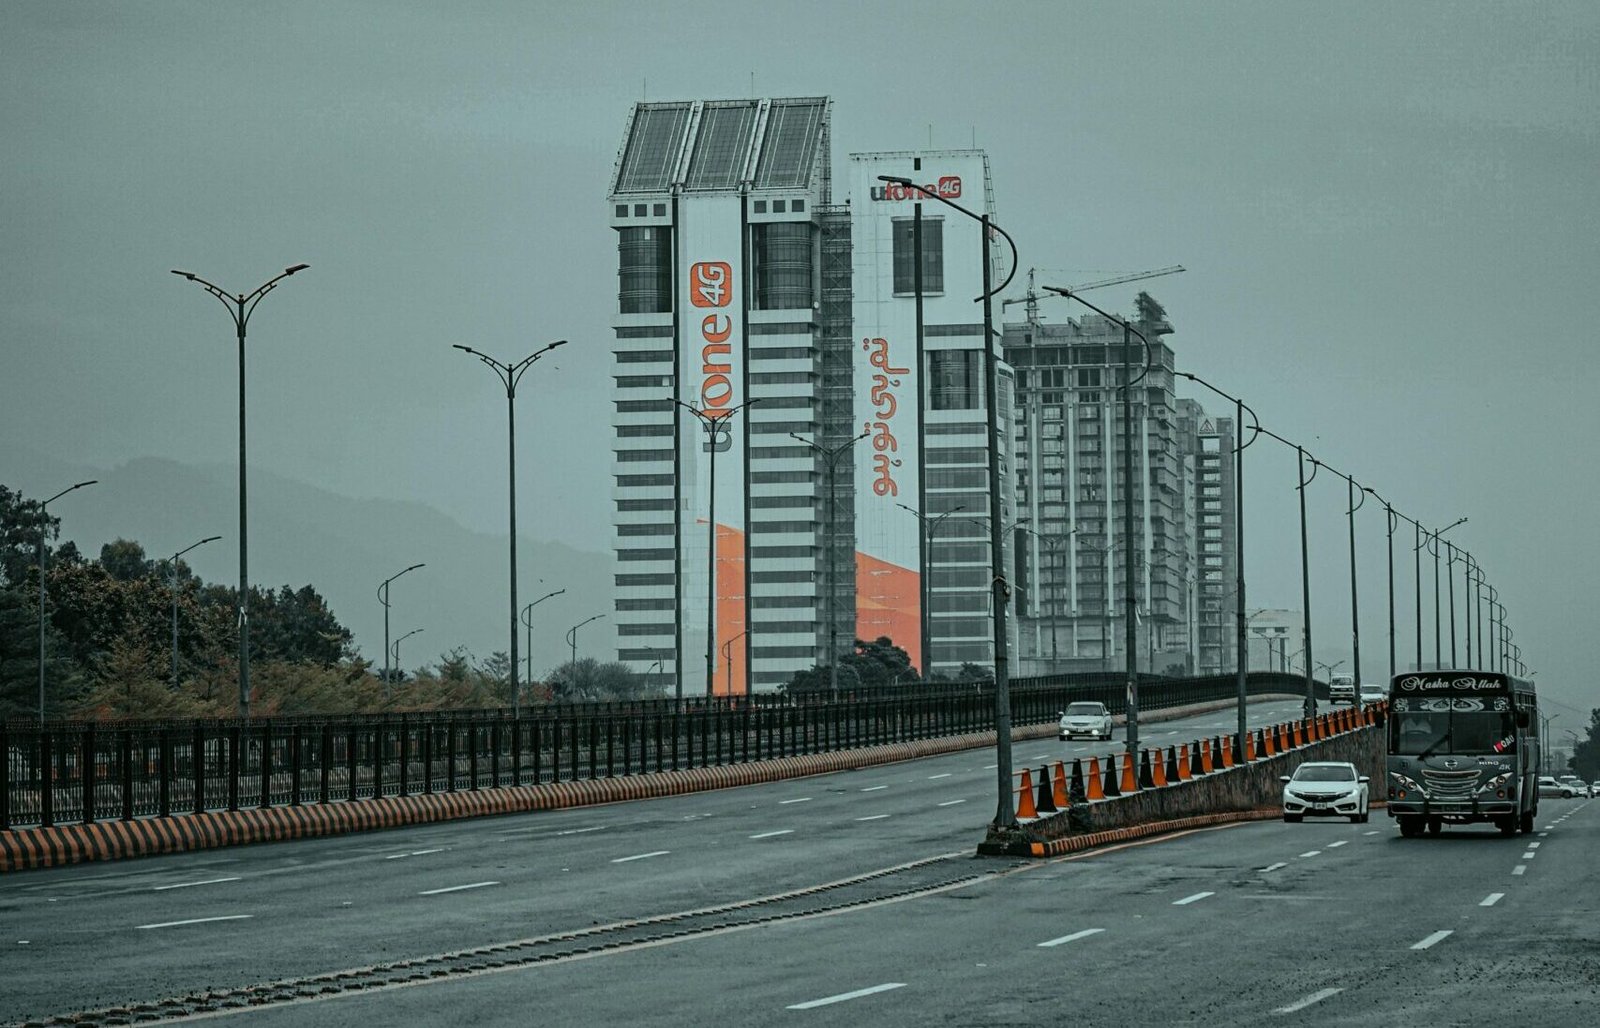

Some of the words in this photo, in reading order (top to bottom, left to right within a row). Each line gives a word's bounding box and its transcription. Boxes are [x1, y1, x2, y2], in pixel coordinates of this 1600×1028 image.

[697, 265, 725, 305] 4G
[1401, 676, 1449, 691] Masha
[1452, 676, 1501, 690] Allah
